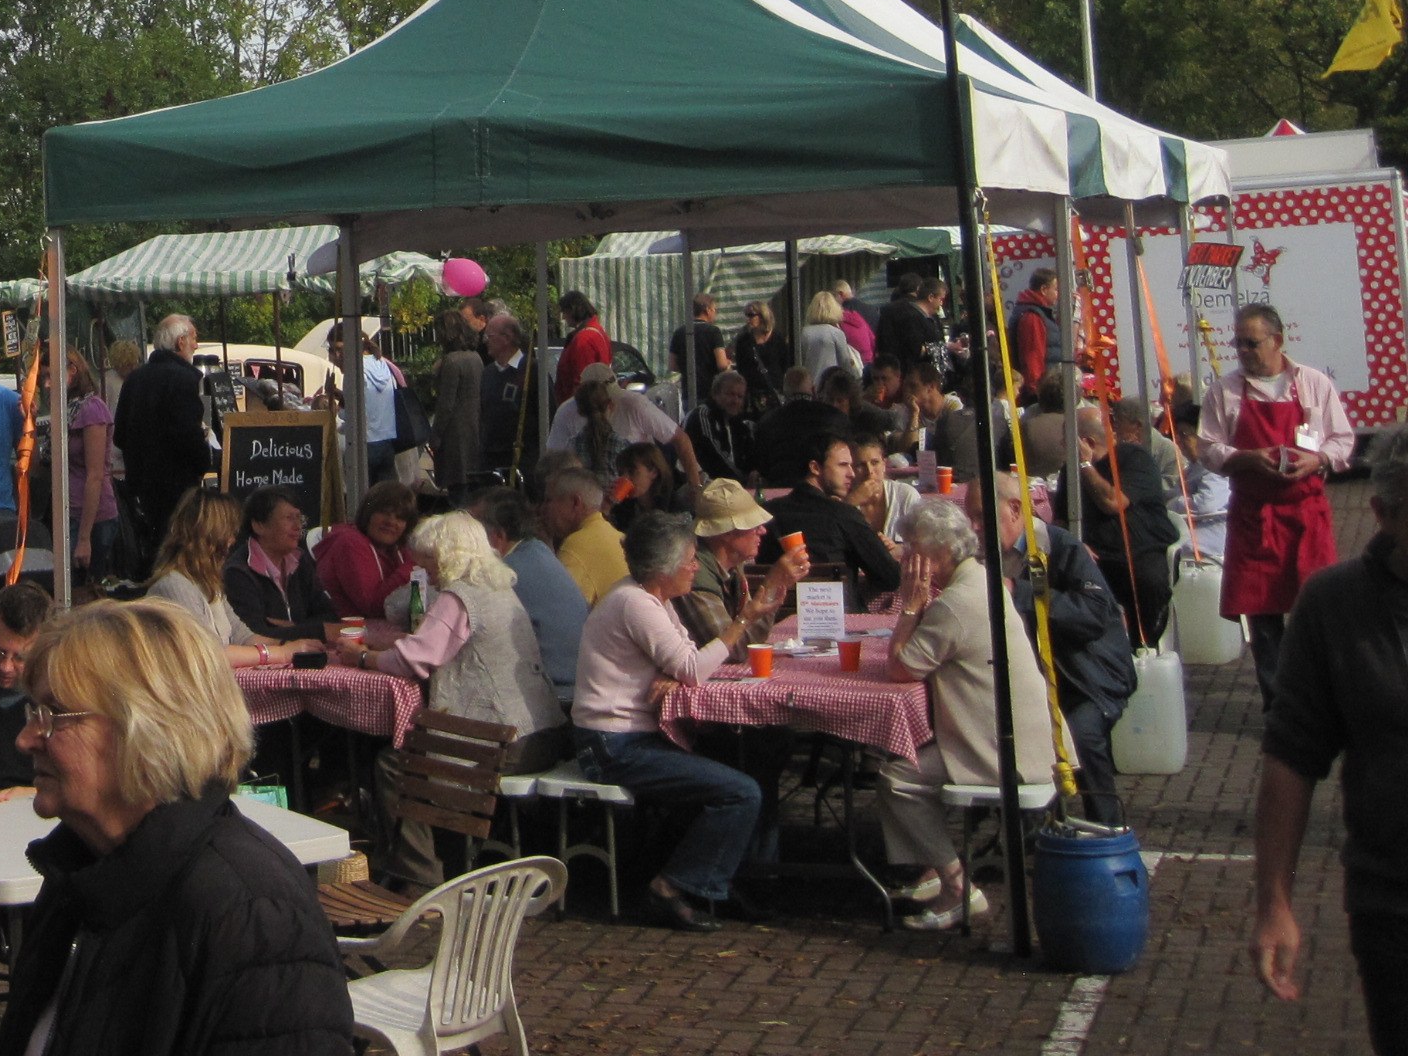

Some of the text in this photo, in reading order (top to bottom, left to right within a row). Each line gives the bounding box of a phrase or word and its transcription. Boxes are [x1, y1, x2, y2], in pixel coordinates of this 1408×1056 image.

[249, 438, 313, 461] Delicious
[236, 467, 305, 488] Home Made
